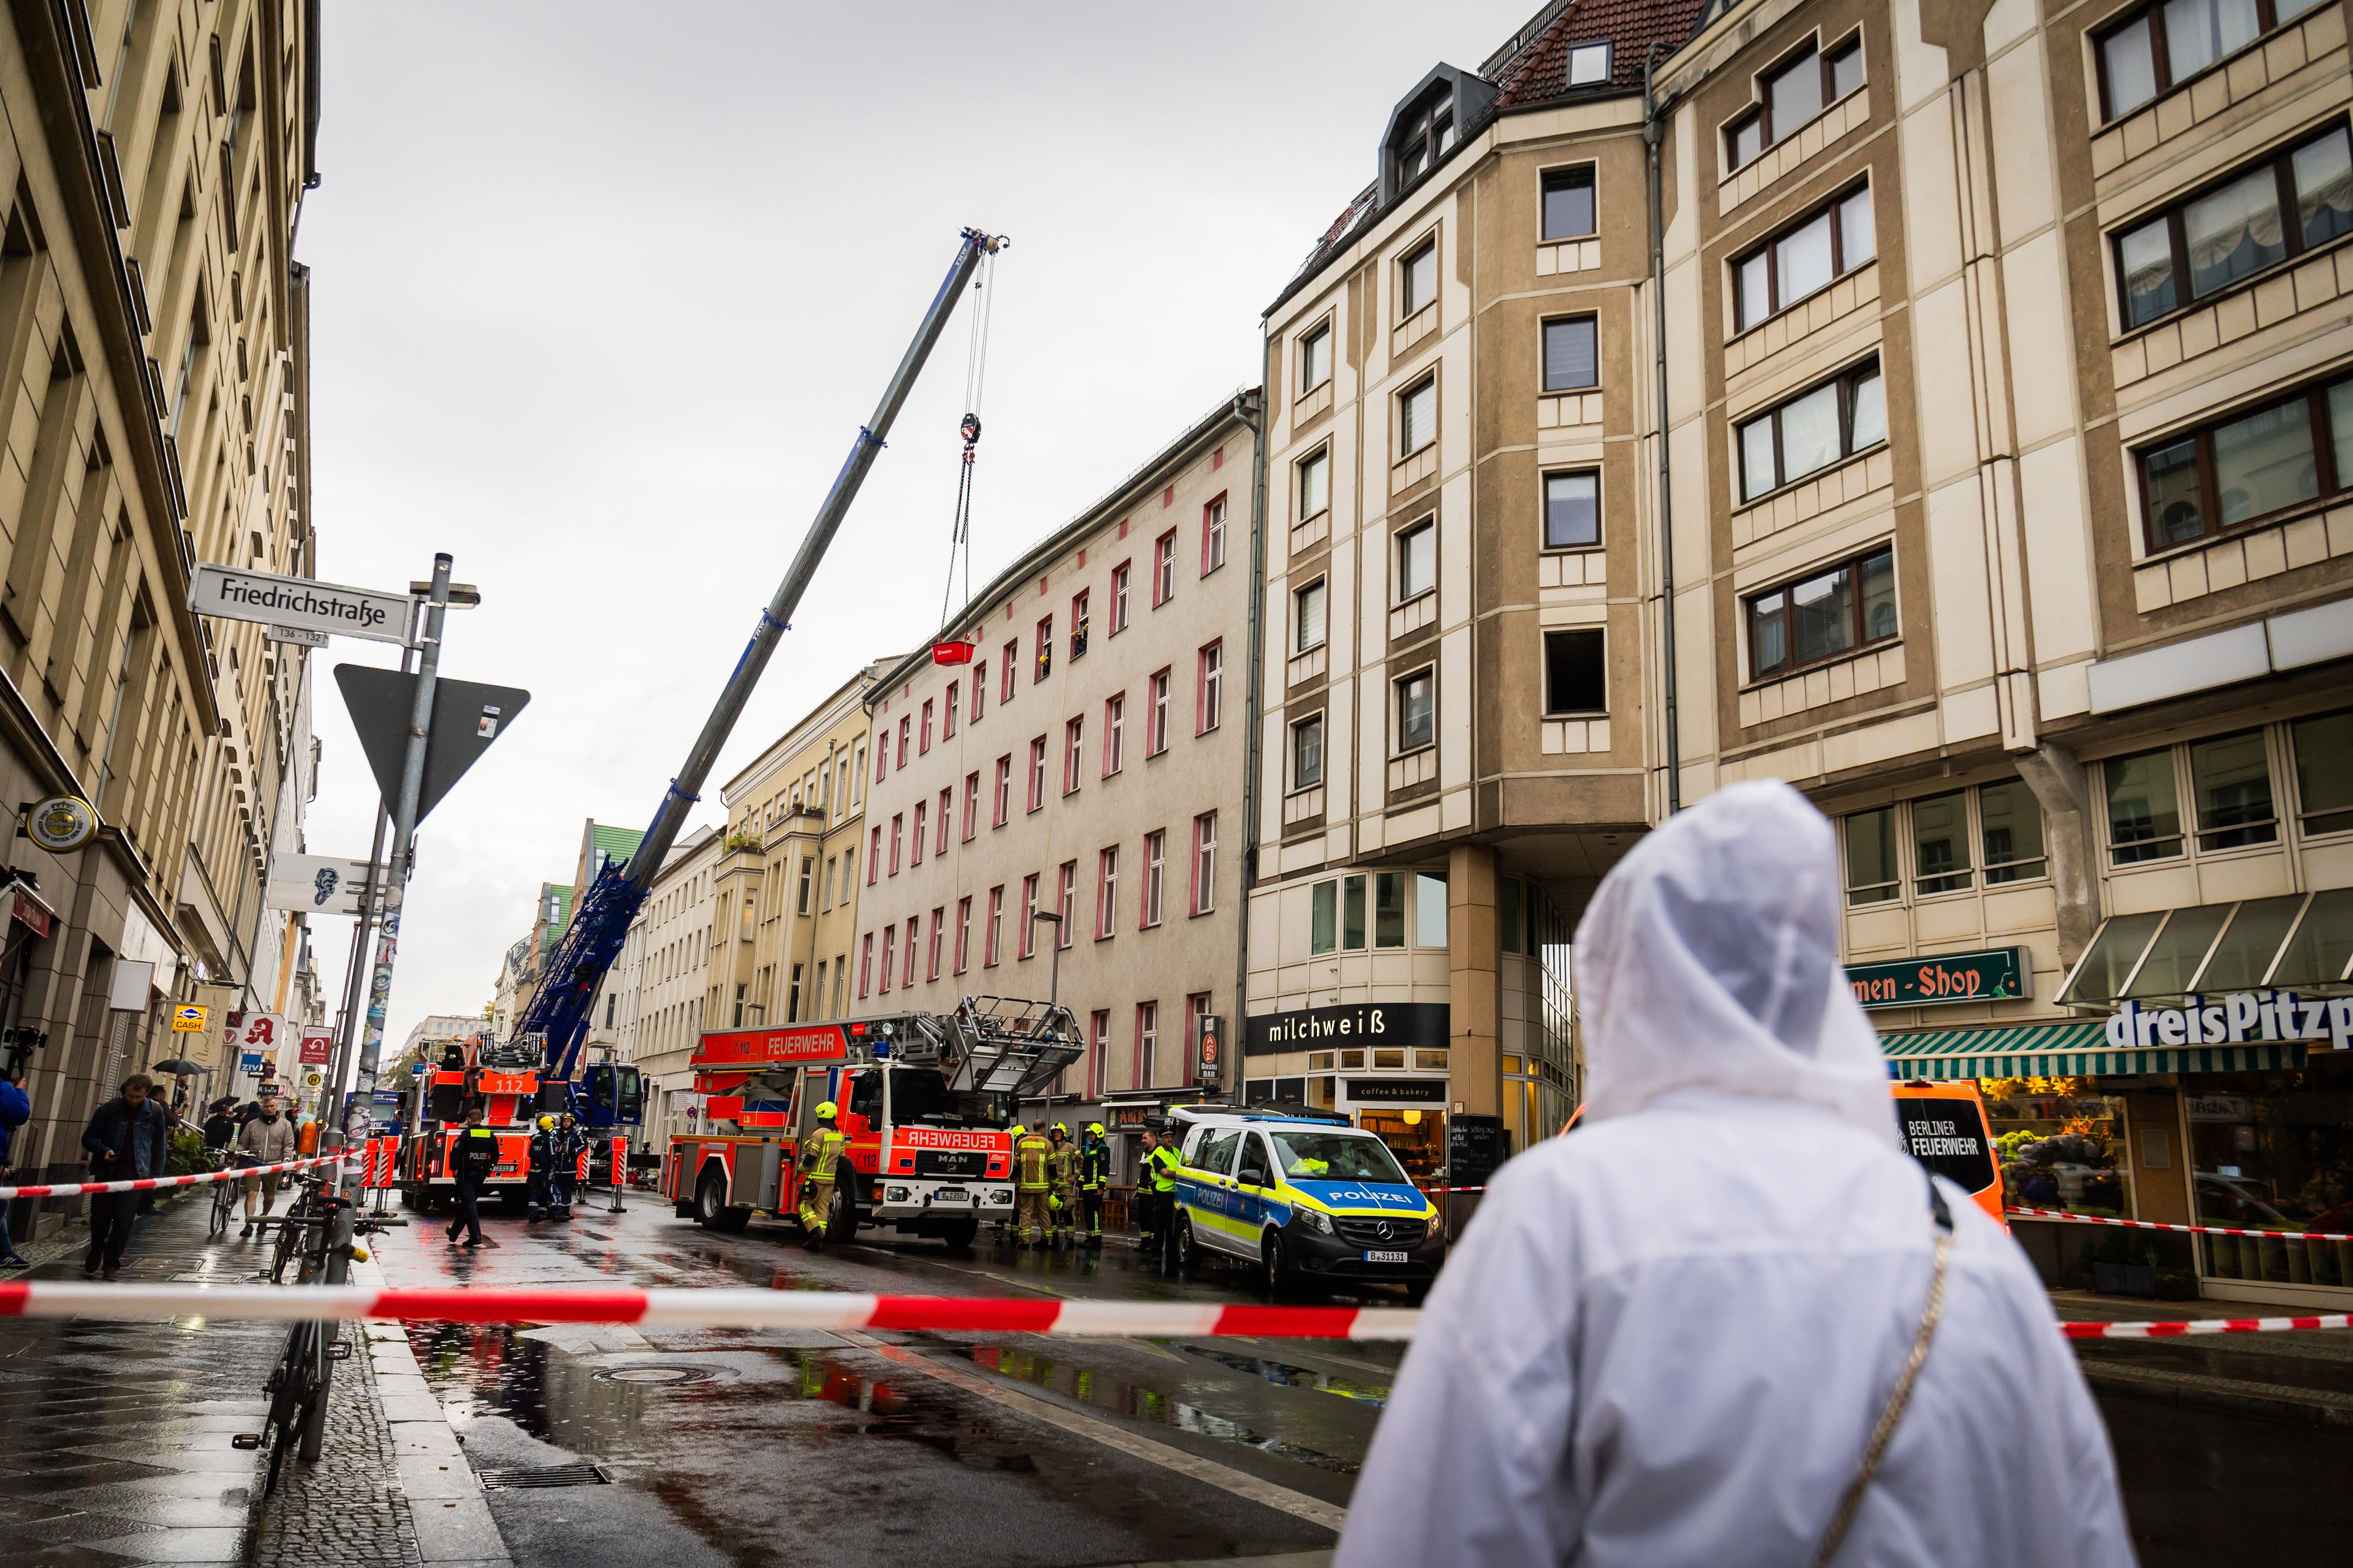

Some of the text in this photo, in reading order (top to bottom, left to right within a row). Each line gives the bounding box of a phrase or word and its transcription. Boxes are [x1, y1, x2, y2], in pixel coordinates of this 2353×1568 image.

[955, 247, 968, 266] THW
[221, 578, 386, 627] Friedrichstraße
[280, 629, 295, 638] 136
[306, 633, 321, 642] 132
[1918, 965, 1980, 999] Shop
[176, 1021, 201, 1029] CASH
[1269, 1010, 1385, 1042] milchweiß
[739, 1042, 751, 1054] 112
[768, 1033, 835, 1055] FEUERWEHR
[496, 1080, 523, 1092] 112
[1400, 1088, 1429, 1096] bakery
[1148, 1107, 1160, 1116] Sushi
[1908, 1121, 1956, 1136] BERLINER
[1912, 1137, 1979, 1156] FEUERWEHR
[864, 1154, 876, 1167] 112
[1197, 1187, 1224, 1209] POLIZEI
[1329, 1192, 1412, 1204] POLIZEI
[1381, 1253, 1404, 1261] 31131
